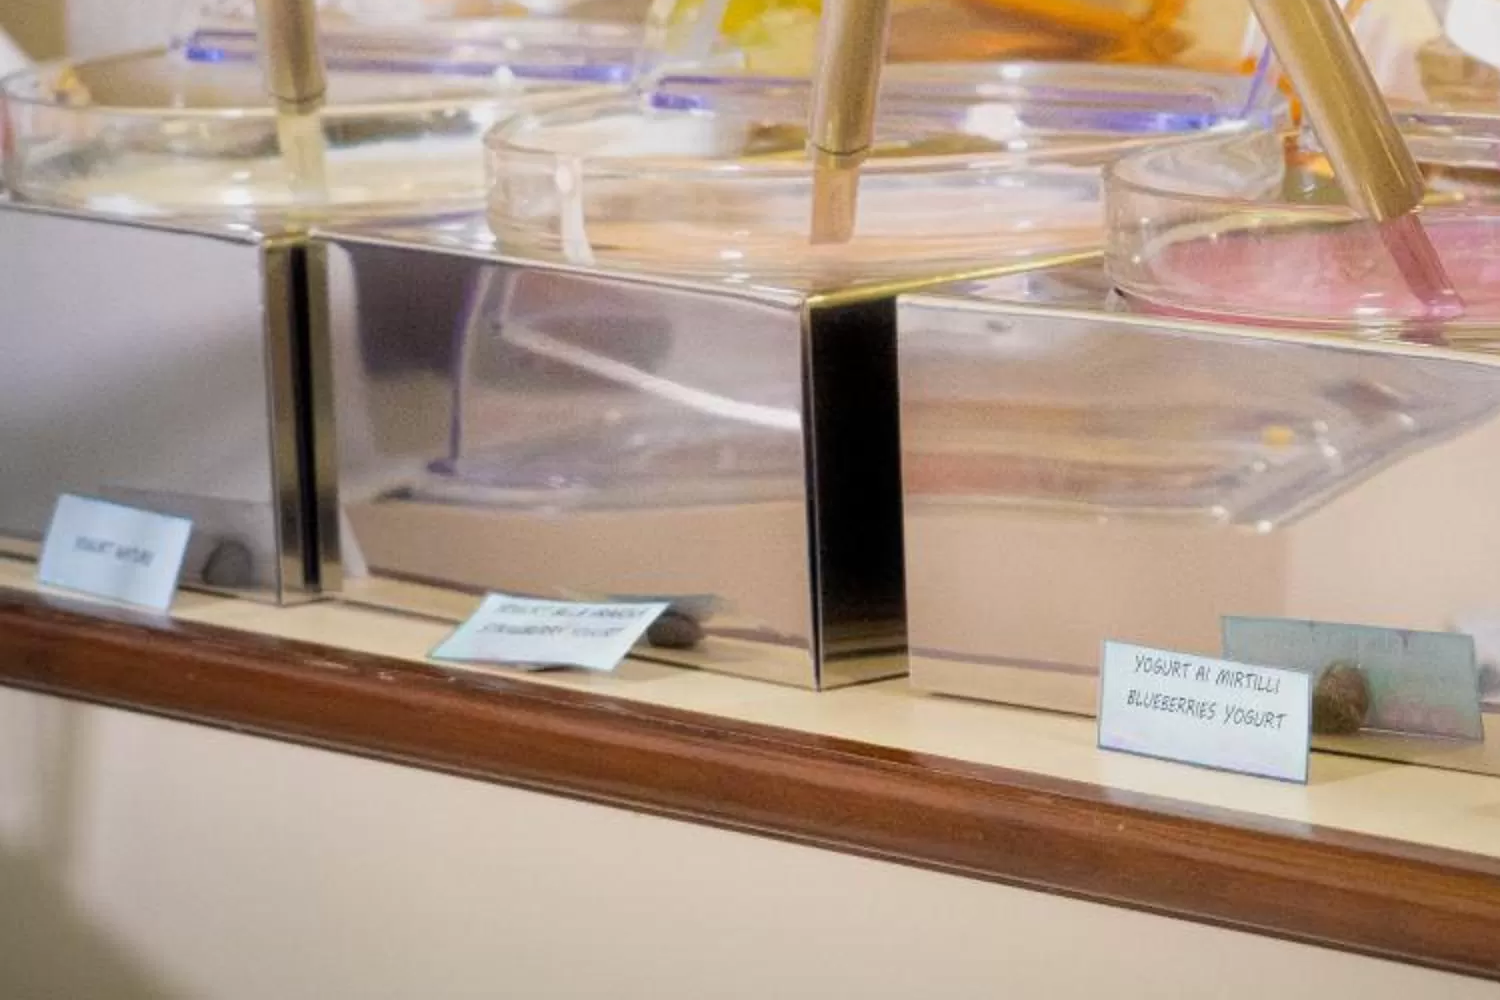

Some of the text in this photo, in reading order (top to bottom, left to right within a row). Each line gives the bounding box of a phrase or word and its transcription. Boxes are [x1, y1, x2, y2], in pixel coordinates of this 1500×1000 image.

[1135, 656, 1280, 693] YOGURT AI MIRTILLI
[1127, 690, 1287, 728] BLUEBERRIES YOGURT
